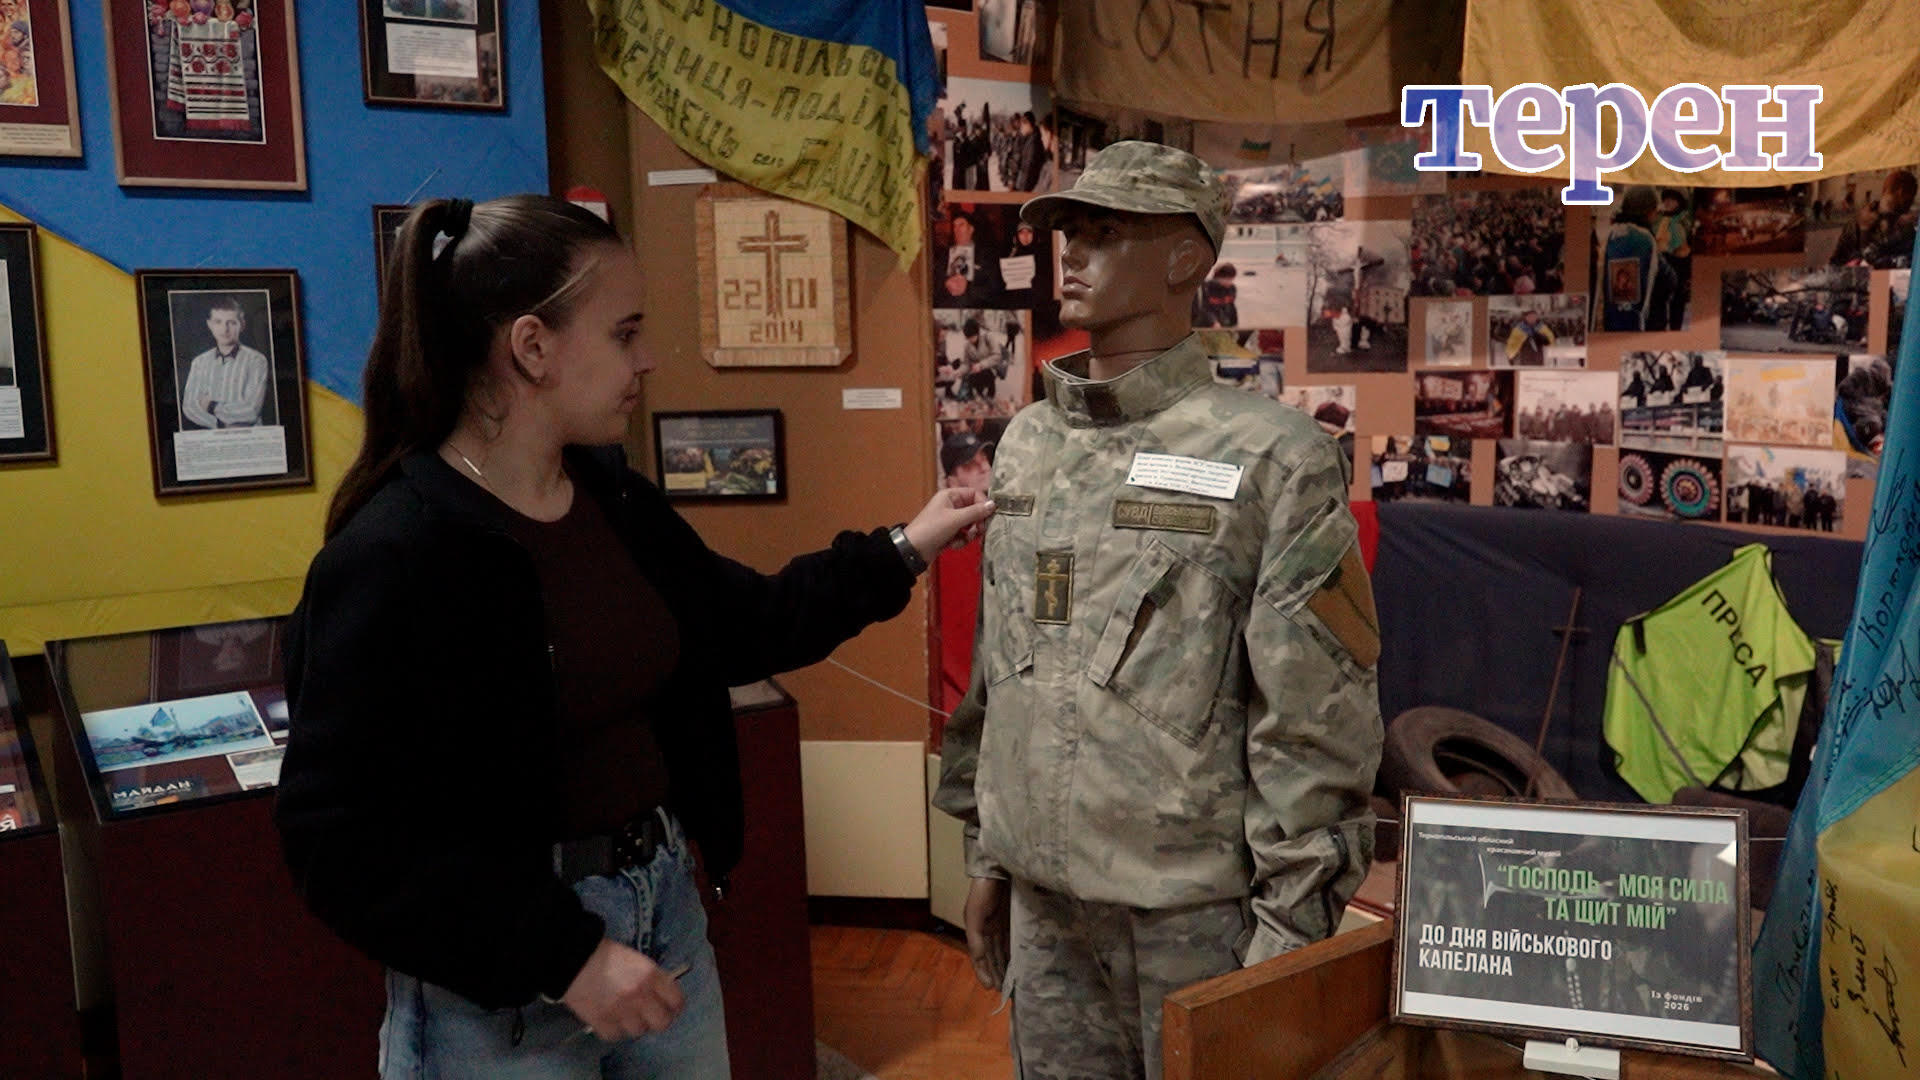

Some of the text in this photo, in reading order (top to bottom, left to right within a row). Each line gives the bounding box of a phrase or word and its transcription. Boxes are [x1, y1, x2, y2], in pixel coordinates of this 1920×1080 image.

[723, 278, 817, 310] 22 01
[750, 320, 803, 343] 2014
[1619, 873, 1664, 899] МОЯ
[1669, 877, 1729, 905] СИЛА
[1545, 898, 1569, 921] ТА
[1575, 899, 1621, 927] ЩИТ
[1419, 924, 1612, 961] ДО ДНЯ ВІЙСЬКОВОГО
[1419, 948, 1513, 976] КАПЕЛАНА
[1664, 1001, 1689, 1011] 2026
